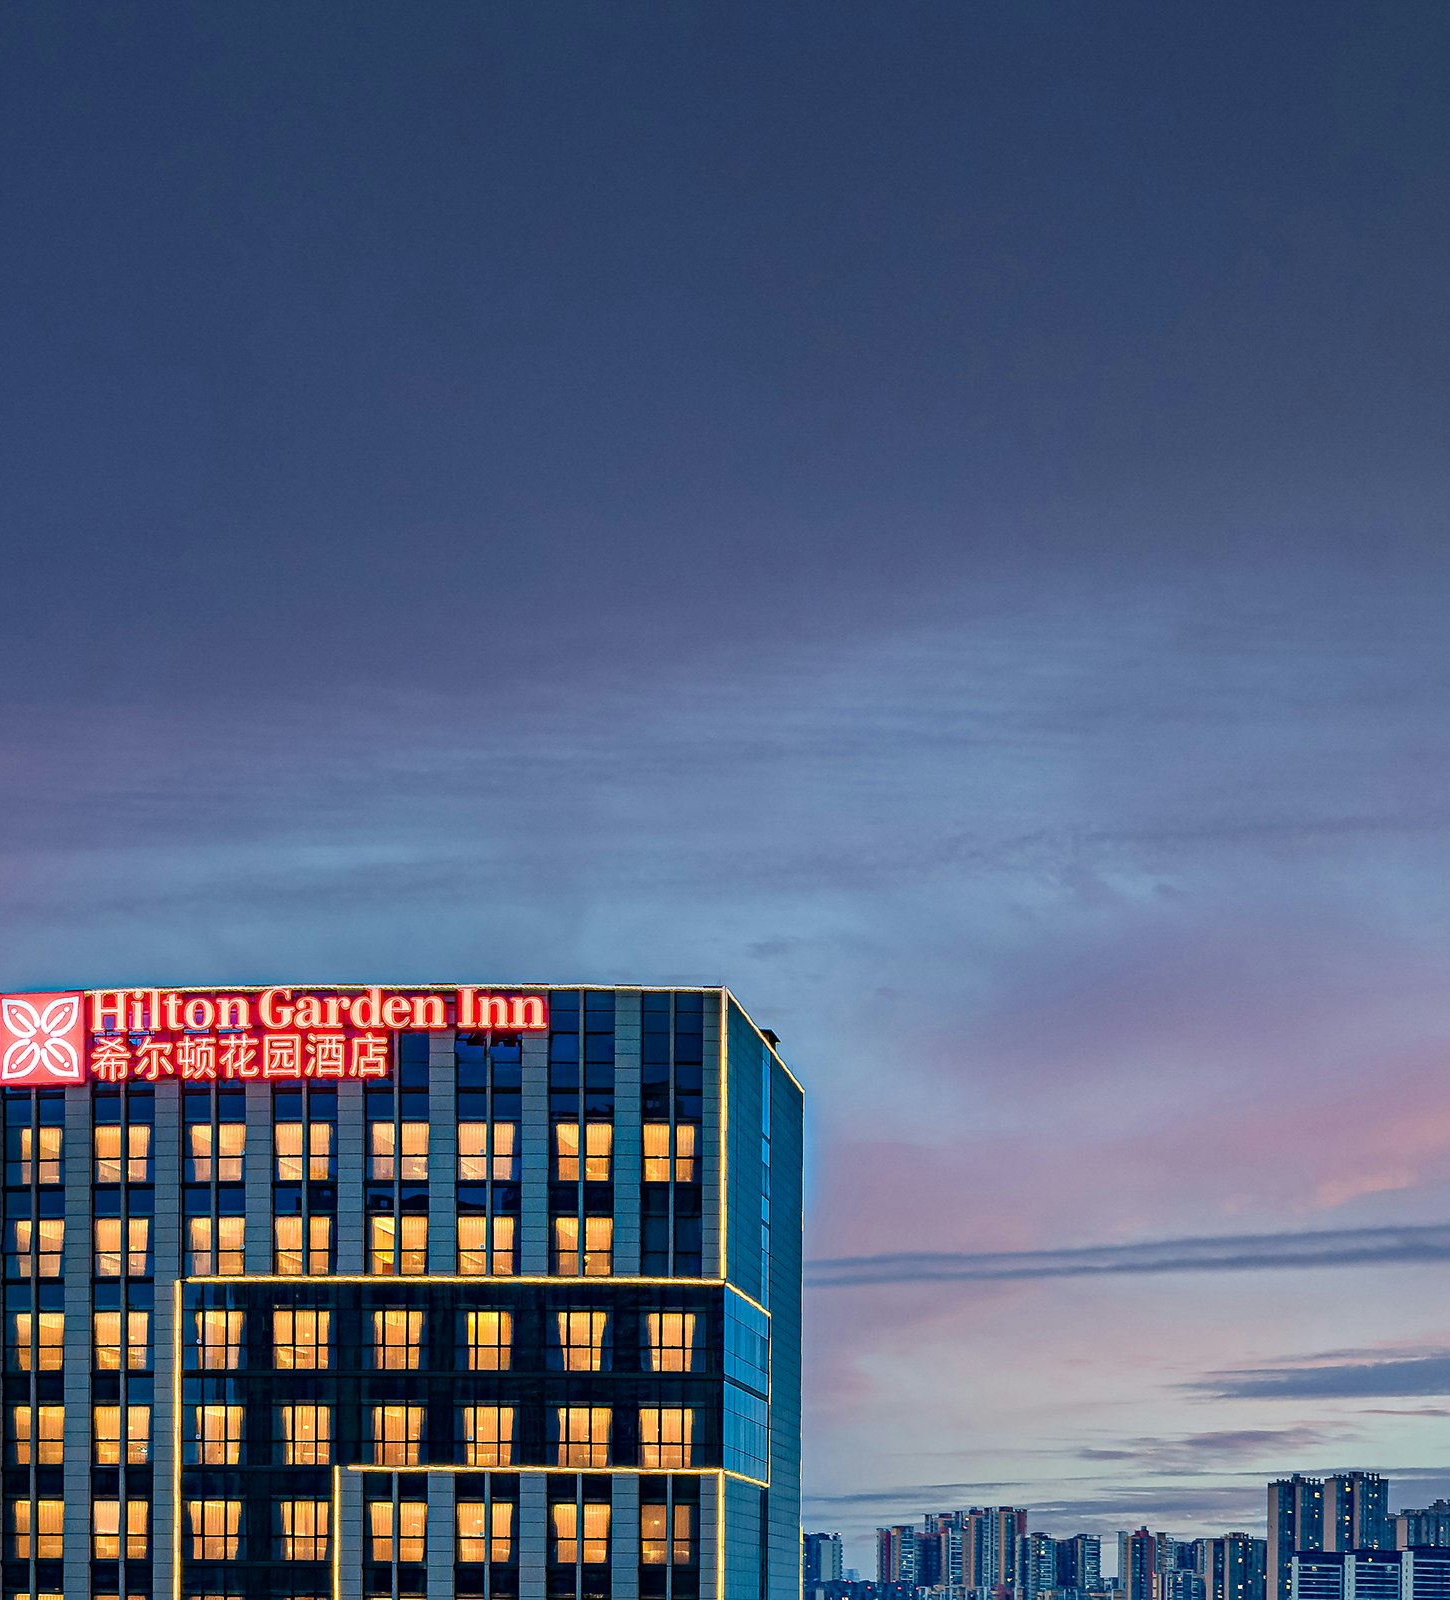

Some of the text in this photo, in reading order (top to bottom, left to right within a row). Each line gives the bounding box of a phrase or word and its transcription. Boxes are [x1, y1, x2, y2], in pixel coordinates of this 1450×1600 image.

[92, 985, 548, 1032] Hilton Garden Inn
[90, 1032, 387, 1082] 希尔顿花园酒店
